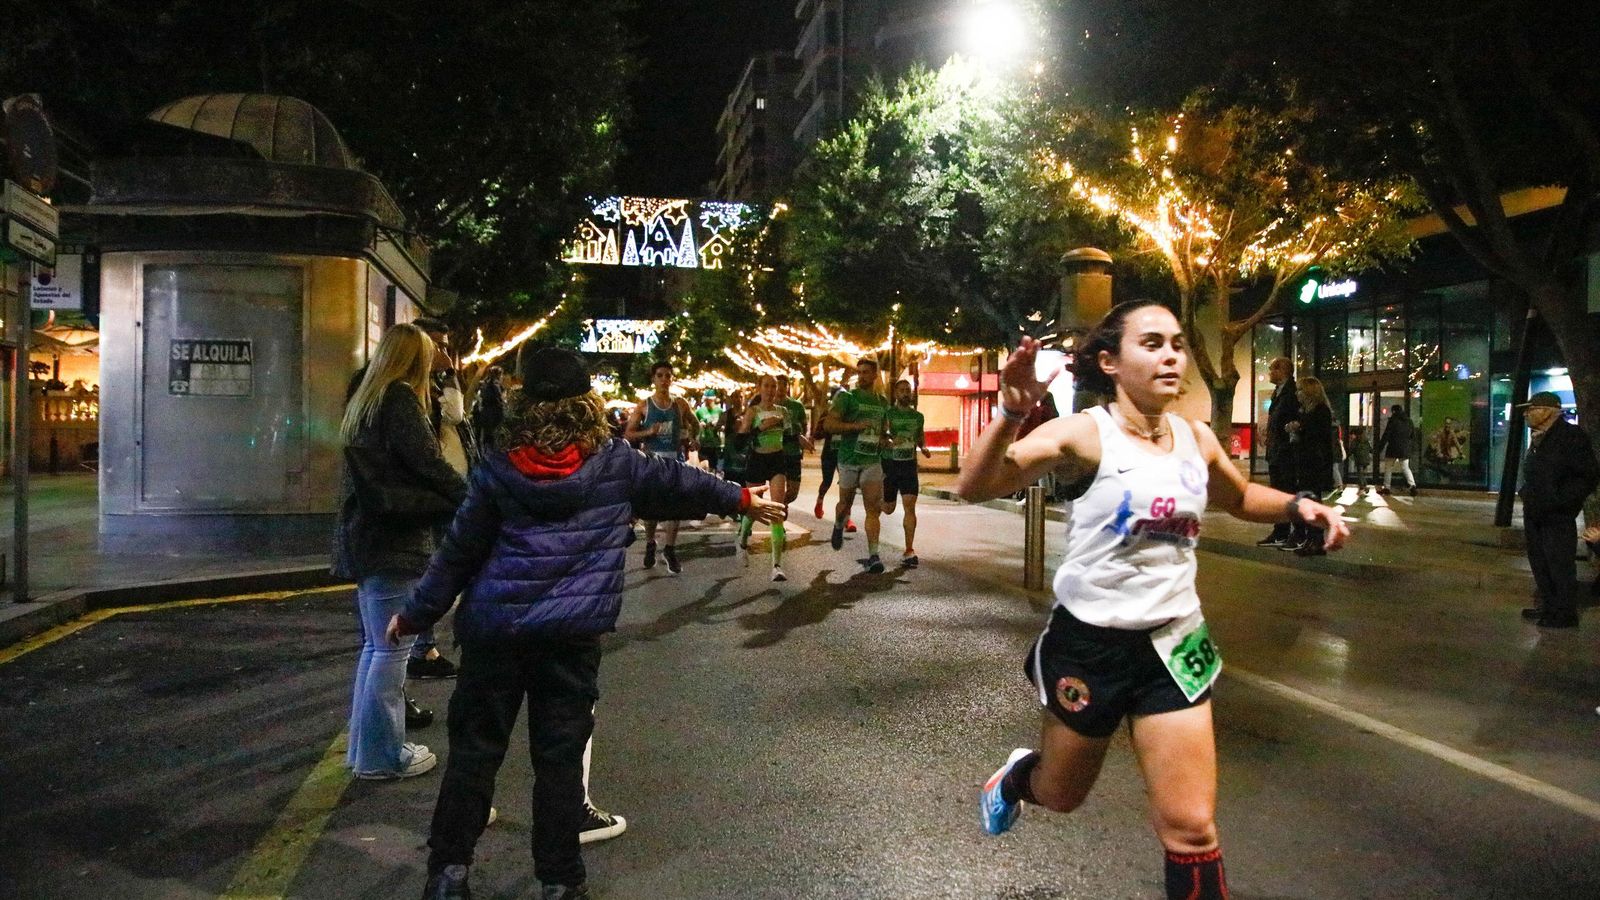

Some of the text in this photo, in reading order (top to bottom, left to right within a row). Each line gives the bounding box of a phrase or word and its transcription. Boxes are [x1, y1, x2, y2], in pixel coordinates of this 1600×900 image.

[172, 344, 250, 362] SE ALQUILA
[1150, 497, 1176, 518] GO
[1183, 637, 1215, 678] 58
